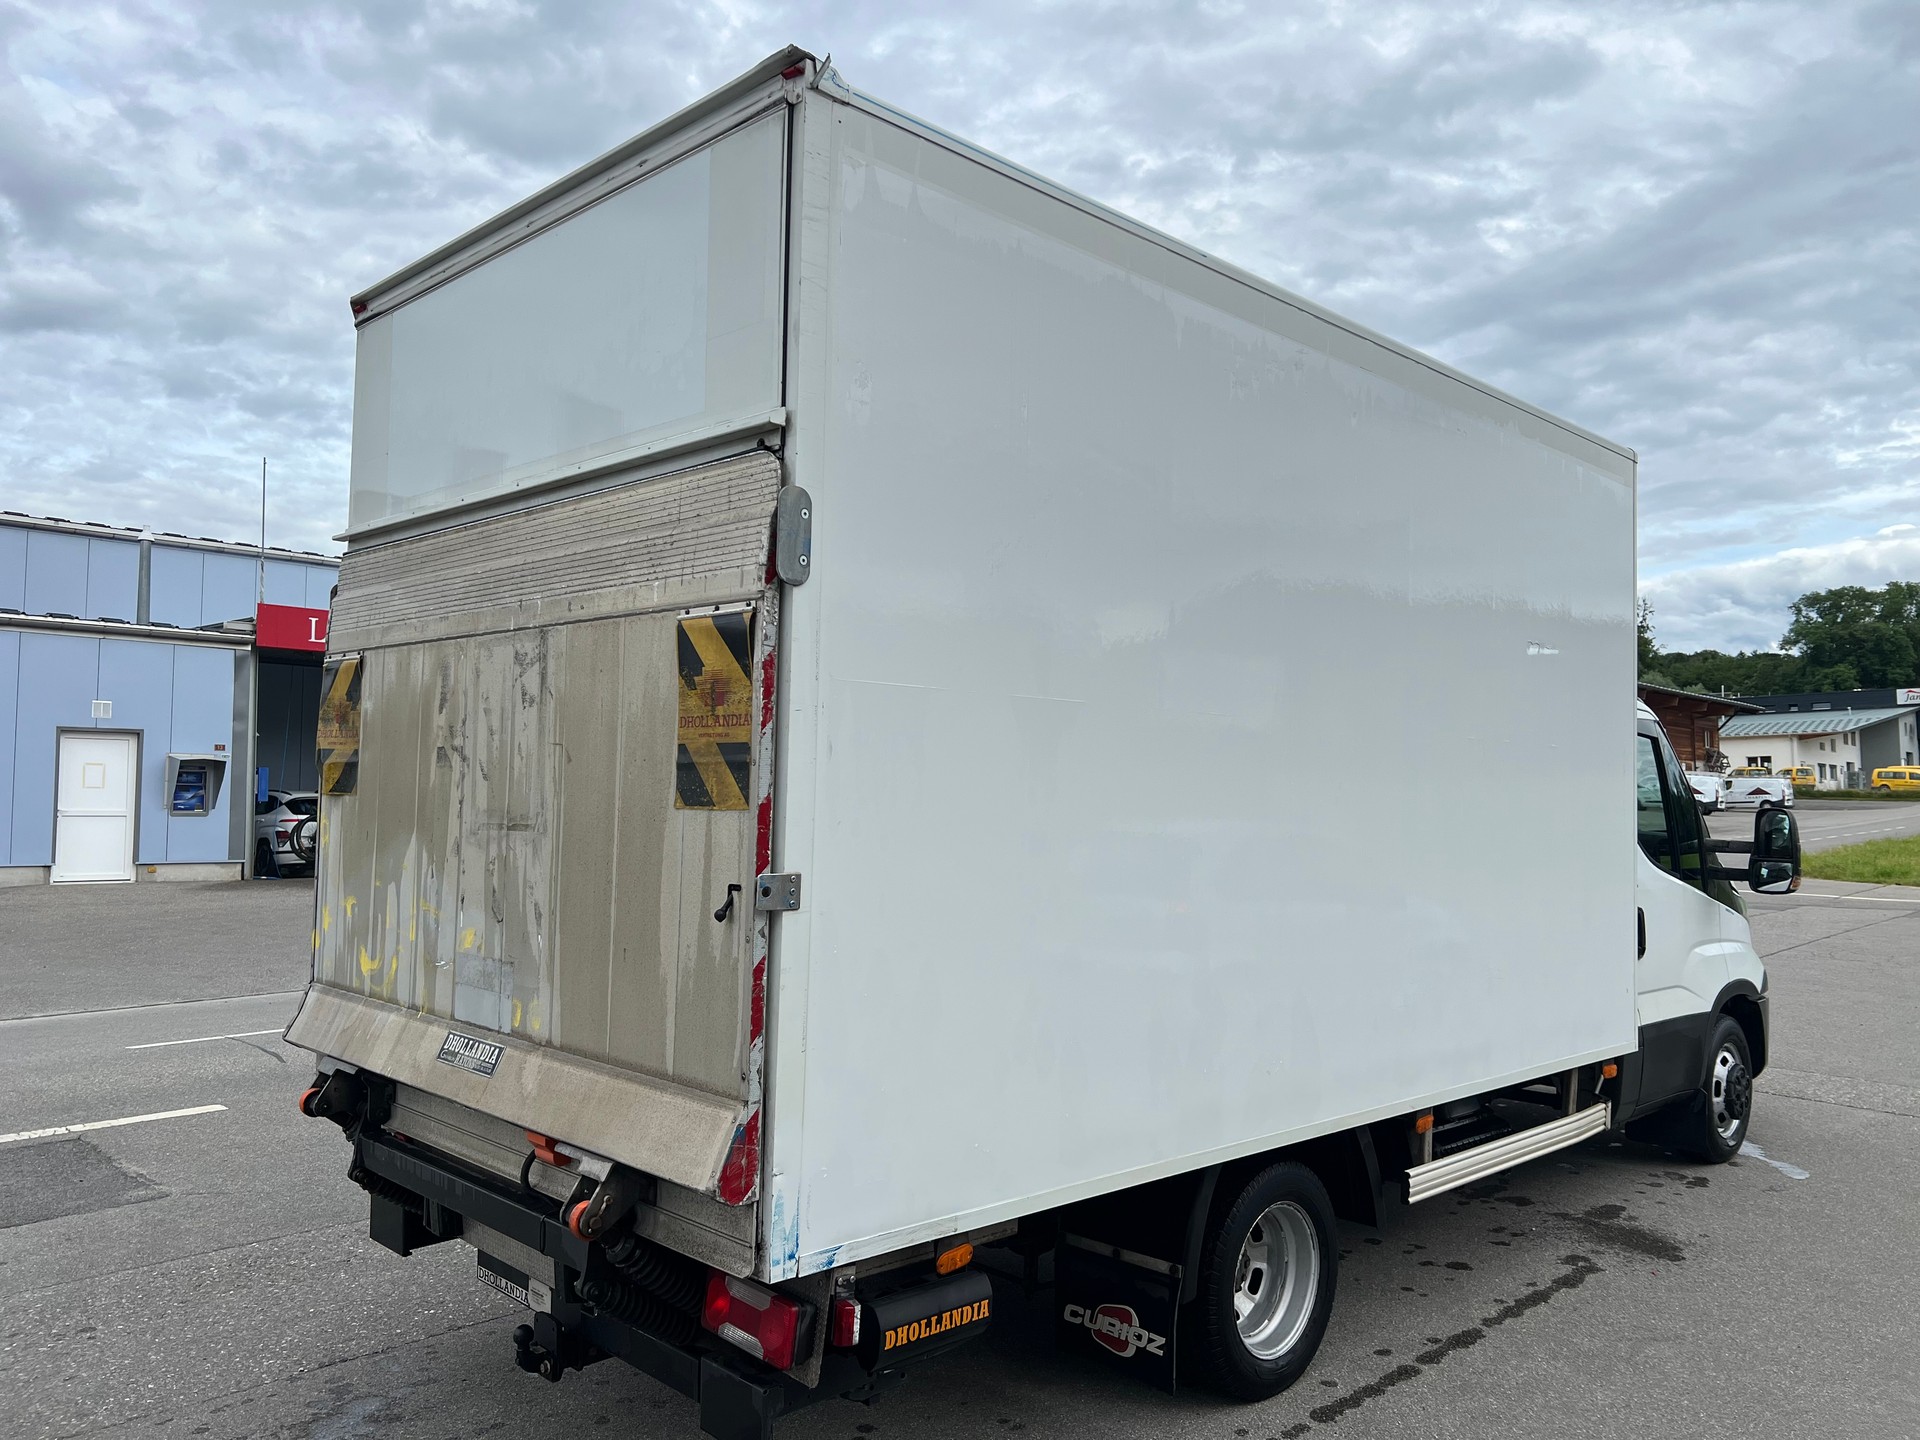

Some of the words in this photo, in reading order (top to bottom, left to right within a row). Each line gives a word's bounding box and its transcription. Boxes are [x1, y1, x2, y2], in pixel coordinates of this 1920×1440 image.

[443, 1034, 500, 1064] DHOLLANDIA
[478, 1267, 529, 1304] DHOLLANDIA
[883, 1298, 989, 1351] DHOLLANDIA
